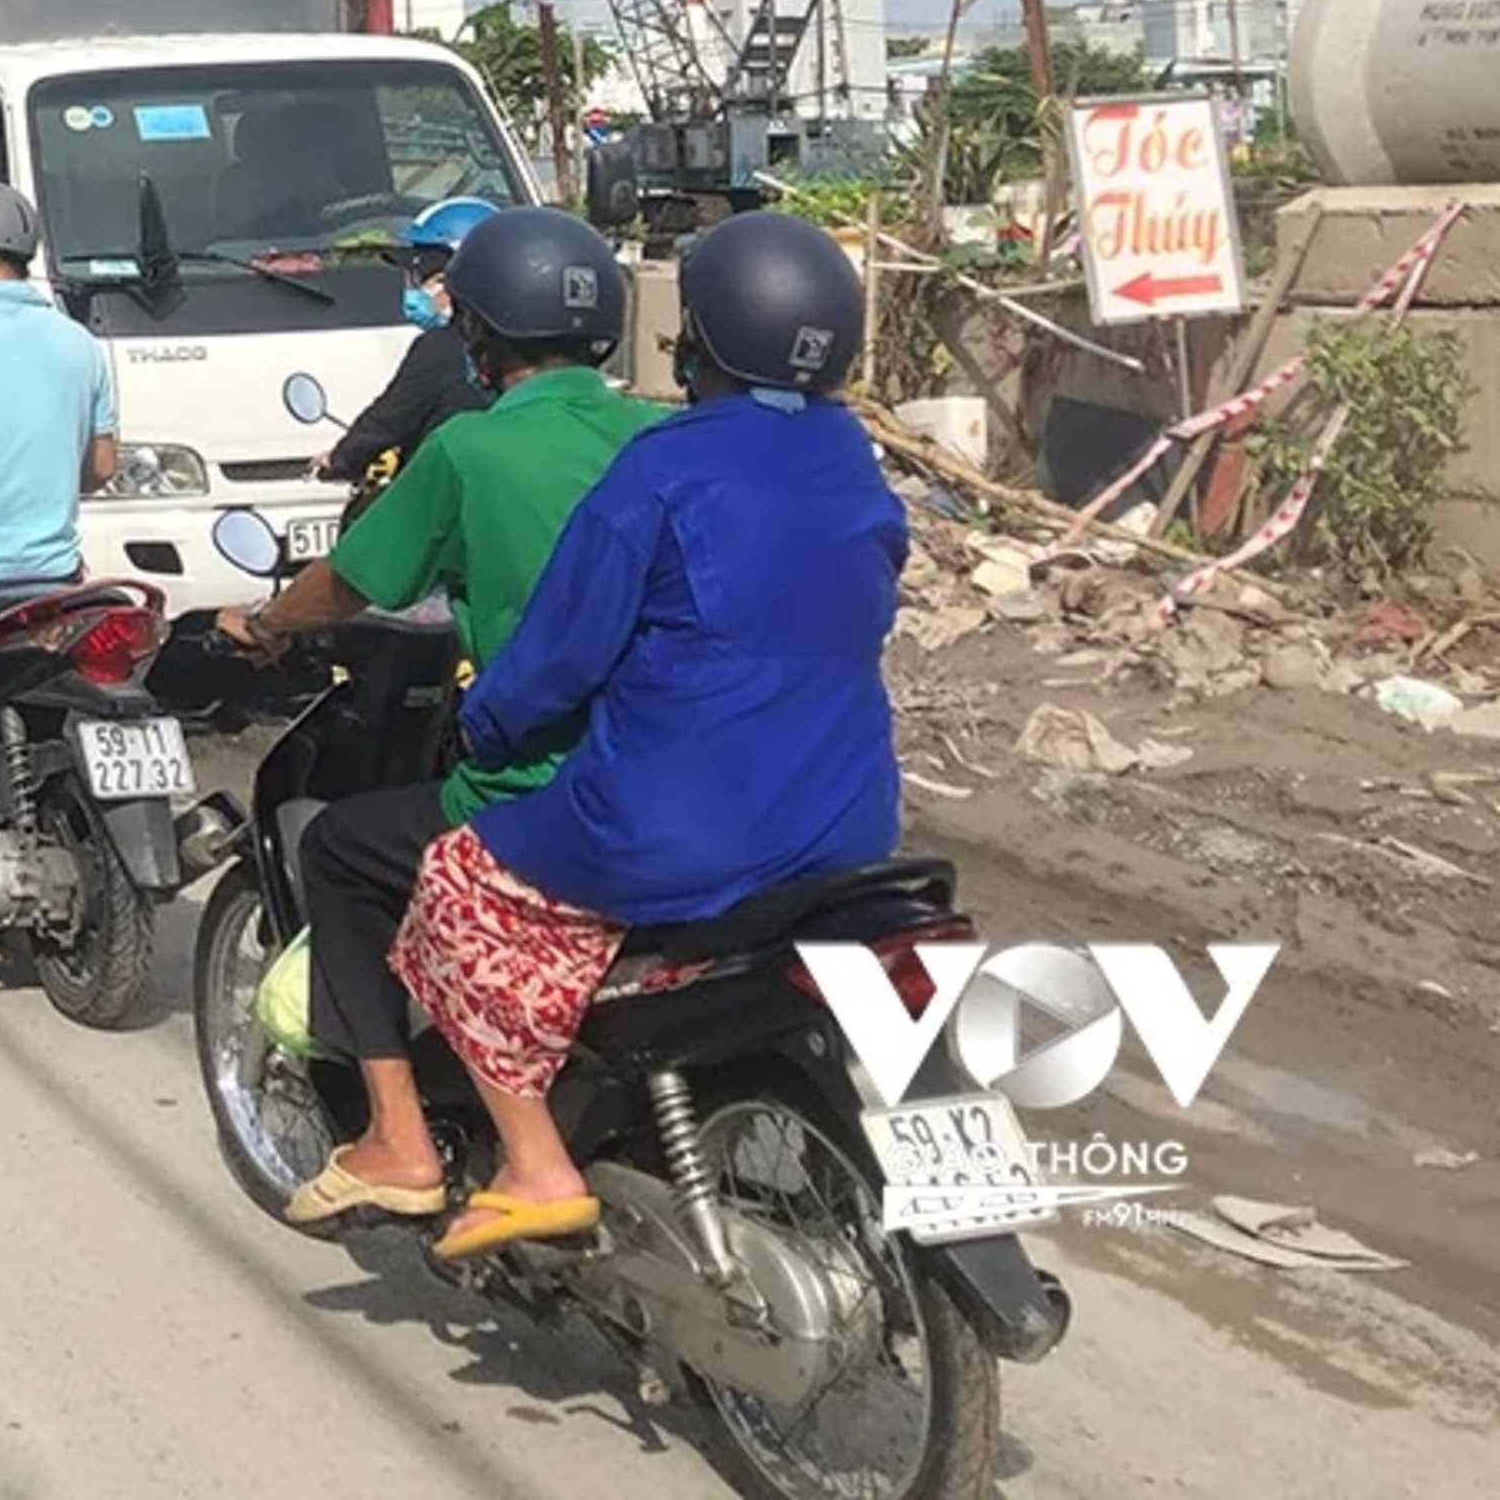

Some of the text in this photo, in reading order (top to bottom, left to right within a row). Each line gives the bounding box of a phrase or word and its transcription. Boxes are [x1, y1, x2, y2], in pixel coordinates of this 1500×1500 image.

[1084, 104, 1209, 177] Tóc
[1090, 190, 1227, 264] Thúy
[126, 346, 207, 363] THACO
